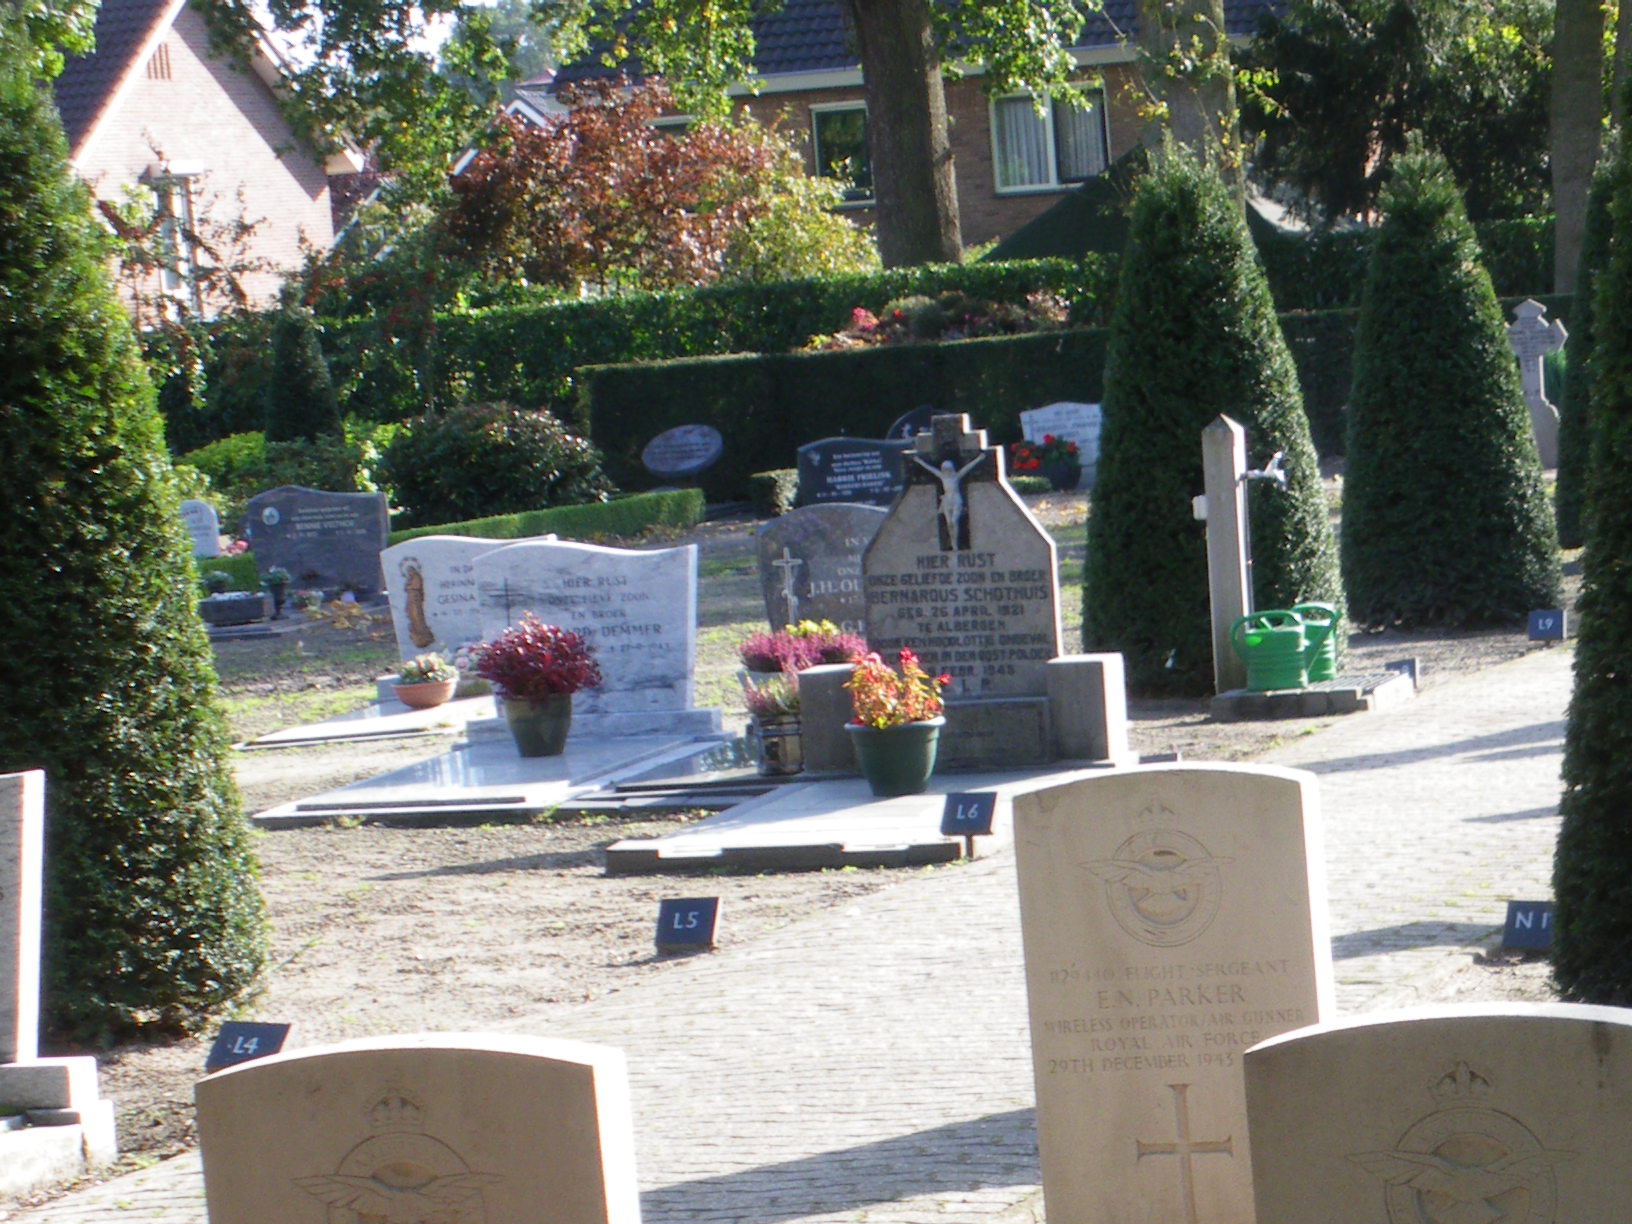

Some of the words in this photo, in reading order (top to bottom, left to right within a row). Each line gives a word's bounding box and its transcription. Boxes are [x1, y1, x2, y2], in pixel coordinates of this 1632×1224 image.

[916, 554, 950, 570] HIER
[957, 552, 996, 568] RUST
[562, 577, 592, 589] HIER
[963, 585, 1049, 602] SCHOTHUIS
[1538, 618, 1554, 630] L9
[956, 803, 979, 820] L6
[673, 911, 699, 930] L5
[1125, 963, 1184, 982] FLIGHT
[1194, 958, 1291, 979] SERGEANT
[1148, 983, 1247, 1009] PARKER
[1044, 1017, 1113, 1036] WIRELESS
[1241, 1008, 1305, 1027] GUNNER
[232, 1035, 260, 1055] L4
[1090, 1034, 1151, 1053] ROYAL
[1161, 1033, 1193, 1050] AIR
[1203, 1029, 1261, 1048] FORCE
[1047, 1058, 1095, 1075] 29TH
[1101, 1054, 1190, 1073] DECEMBER
